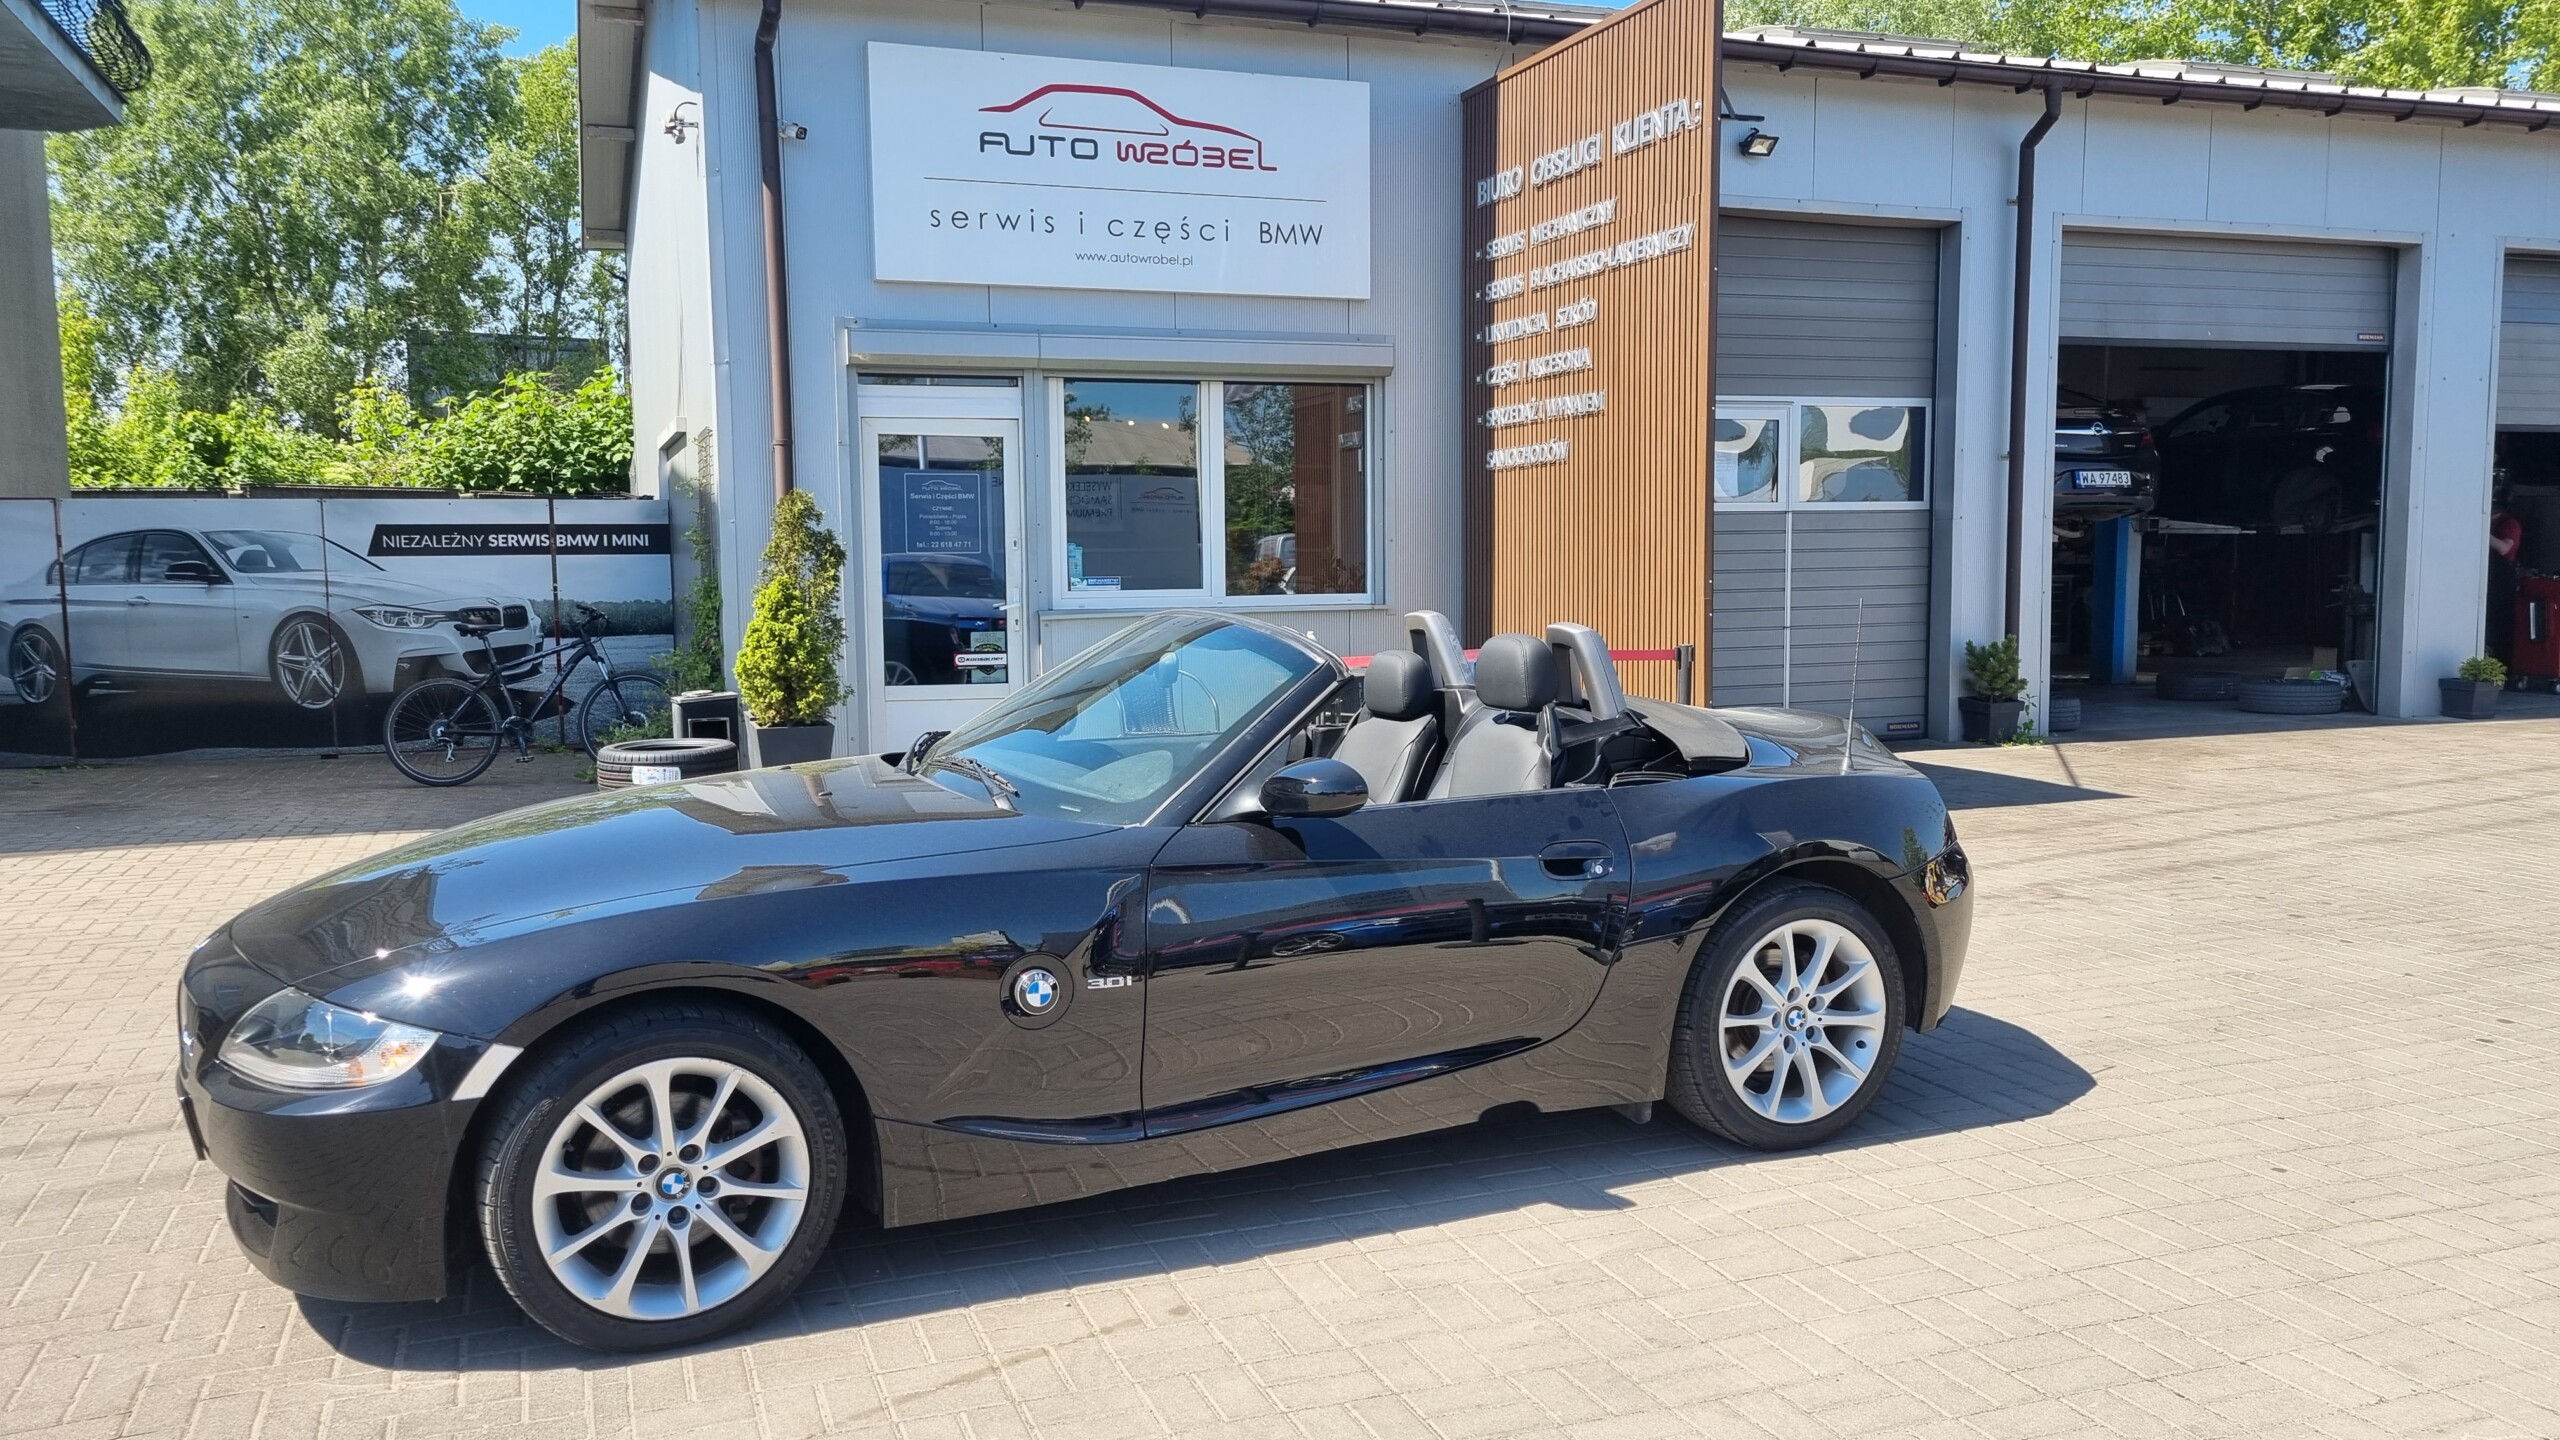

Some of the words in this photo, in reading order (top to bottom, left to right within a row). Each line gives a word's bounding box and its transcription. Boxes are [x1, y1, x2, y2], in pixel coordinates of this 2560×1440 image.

[980, 131, 1099, 160] AUTO
[1117, 138, 1277, 172] WRÓBEL
[1477, 164, 1524, 208] BIURO
[1531, 131, 1603, 187] OBSŁUGI
[930, 207, 1055, 234] serwis
[1078, 211, 1084, 235] i
[1107, 216, 1229, 245] części
[1260, 222, 1323, 246] BMW
[1486, 230, 1526, 261] SERWIS
[1531, 196, 1618, 248] MECHANICZNY
[1075, 251, 1193, 267] www.autowrobel.pl
[1486, 272, 1525, 303] SERWIS
[1530, 220, 1697, 291] BLACHARSKO-LAKIERNICZY
[1486, 312, 1549, 345] LIKWIDACJA
[1555, 295, 1597, 331] SZKÓD
[1486, 357, 1520, 389] CZĘŚCI
[1528, 346, 1593, 380] AKCESORIA
[1486, 397, 1537, 428] SPRZEDAŻ
[1547, 391, 1606, 420] WYNAJEM
[1486, 436, 1569, 470] SAMOCHODÓW
[2081, 472, 2097, 484] WA
[2099, 472, 2130, 484] 97483
[382, 531, 485, 548] NIEZALEŻNY
[488, 534, 550, 547] SERWIS
[556, 533, 599, 547] BMW
[603, 534, 608, 547] I
[612, 534, 649, 547] MINI
